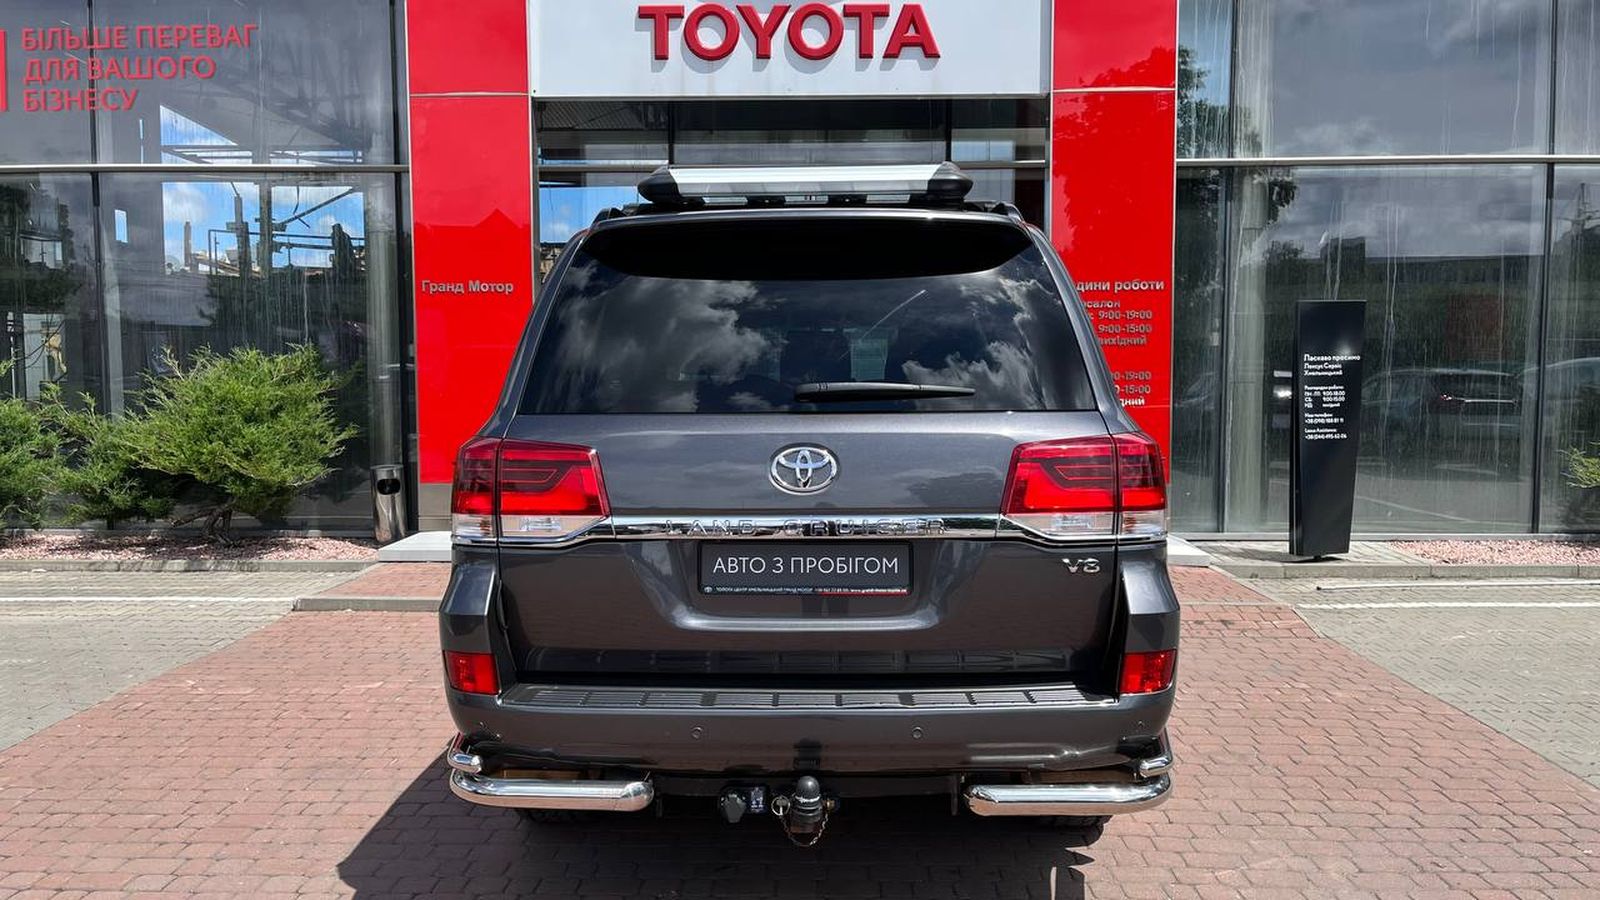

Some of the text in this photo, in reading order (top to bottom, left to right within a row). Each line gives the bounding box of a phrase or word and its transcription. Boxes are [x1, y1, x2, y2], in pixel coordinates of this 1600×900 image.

[22, 24, 258, 51] БІЛЬШЕ ПЕРЕВАГ
[638, 2, 941, 61] TOYOTA
[23, 56, 218, 84] ДЛЯ ВАШОГО
[23, 88, 138, 112] БІЗНЕСУ
[421, 279, 514, 295] Гранд Мотор
[1114, 280, 1165, 293] роботи
[664, 517, 948, 536] LAND CRUISER
[712, 556, 899, 574] АВТО З ПРОБІГОМ
[1061, 557, 1100, 573] V8
